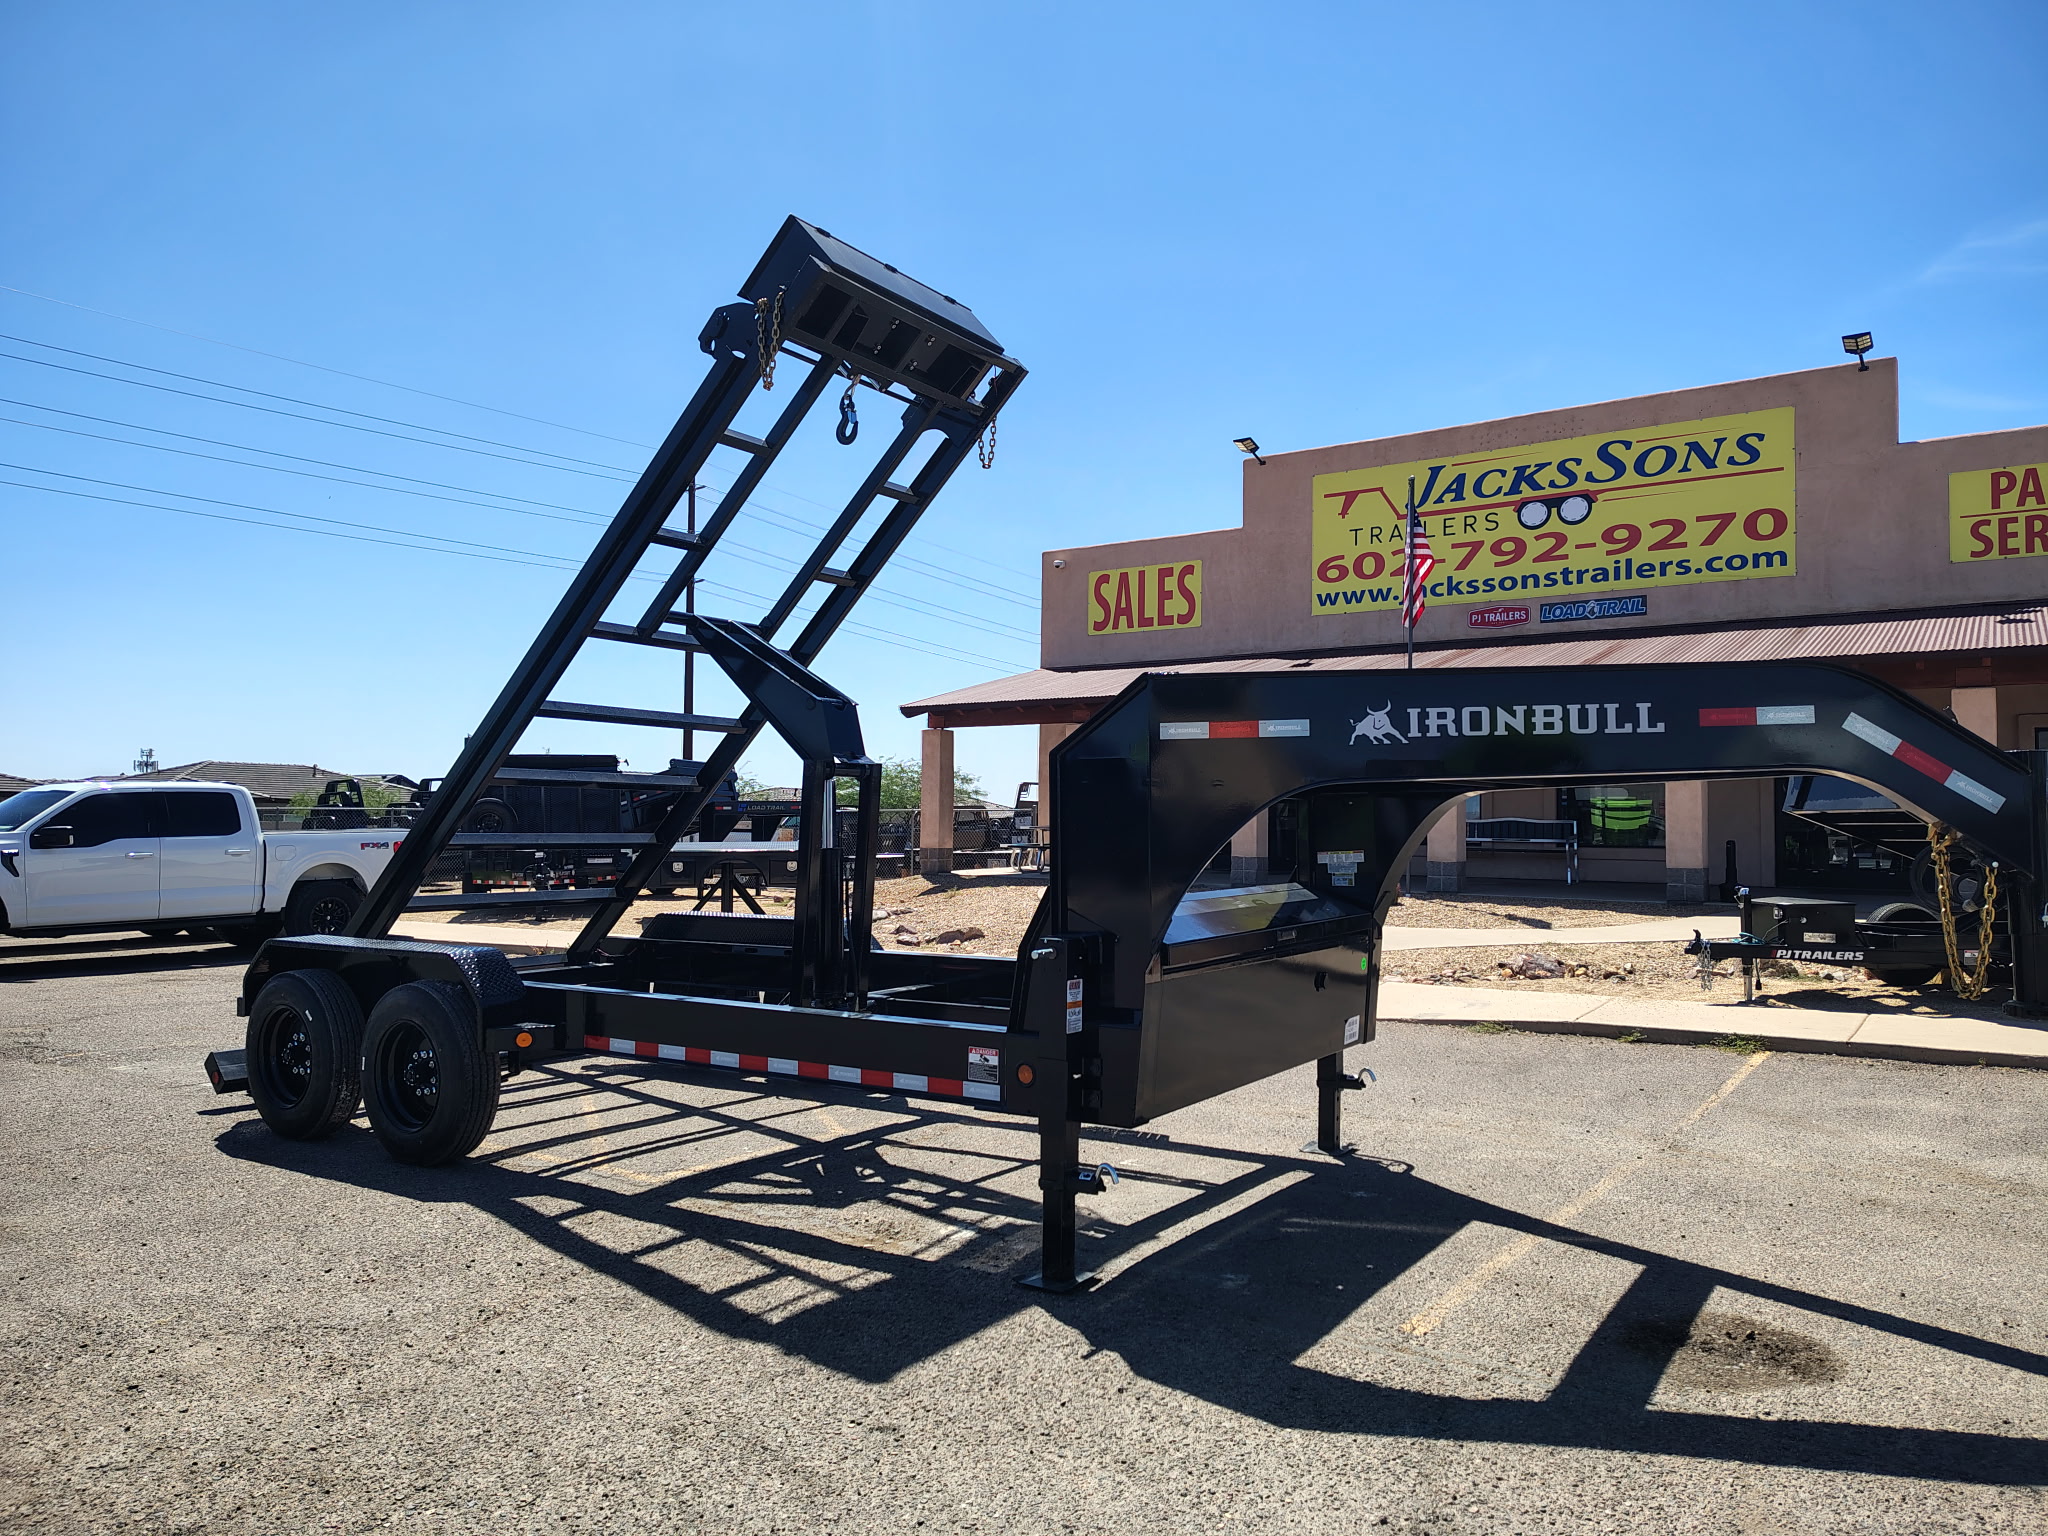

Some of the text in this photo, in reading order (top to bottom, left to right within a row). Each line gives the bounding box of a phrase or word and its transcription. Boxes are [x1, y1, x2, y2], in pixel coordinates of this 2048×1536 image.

[1349, 512, 1500, 547] TRALERS
[1316, 549, 1789, 607] www.ckssonstrailers.com
[1092, 563, 1197, 632] SALES
[1541, 598, 1647, 621] LOAD TRAIL
[1471, 614, 1482, 624] PJ
[1483, 610, 1527, 622] TRAILERS
[1405, 702, 1666, 738] IRONBULL
[360, 841, 390, 851] FX4
[1776, 949, 1865, 961] PJ TRAILERS
